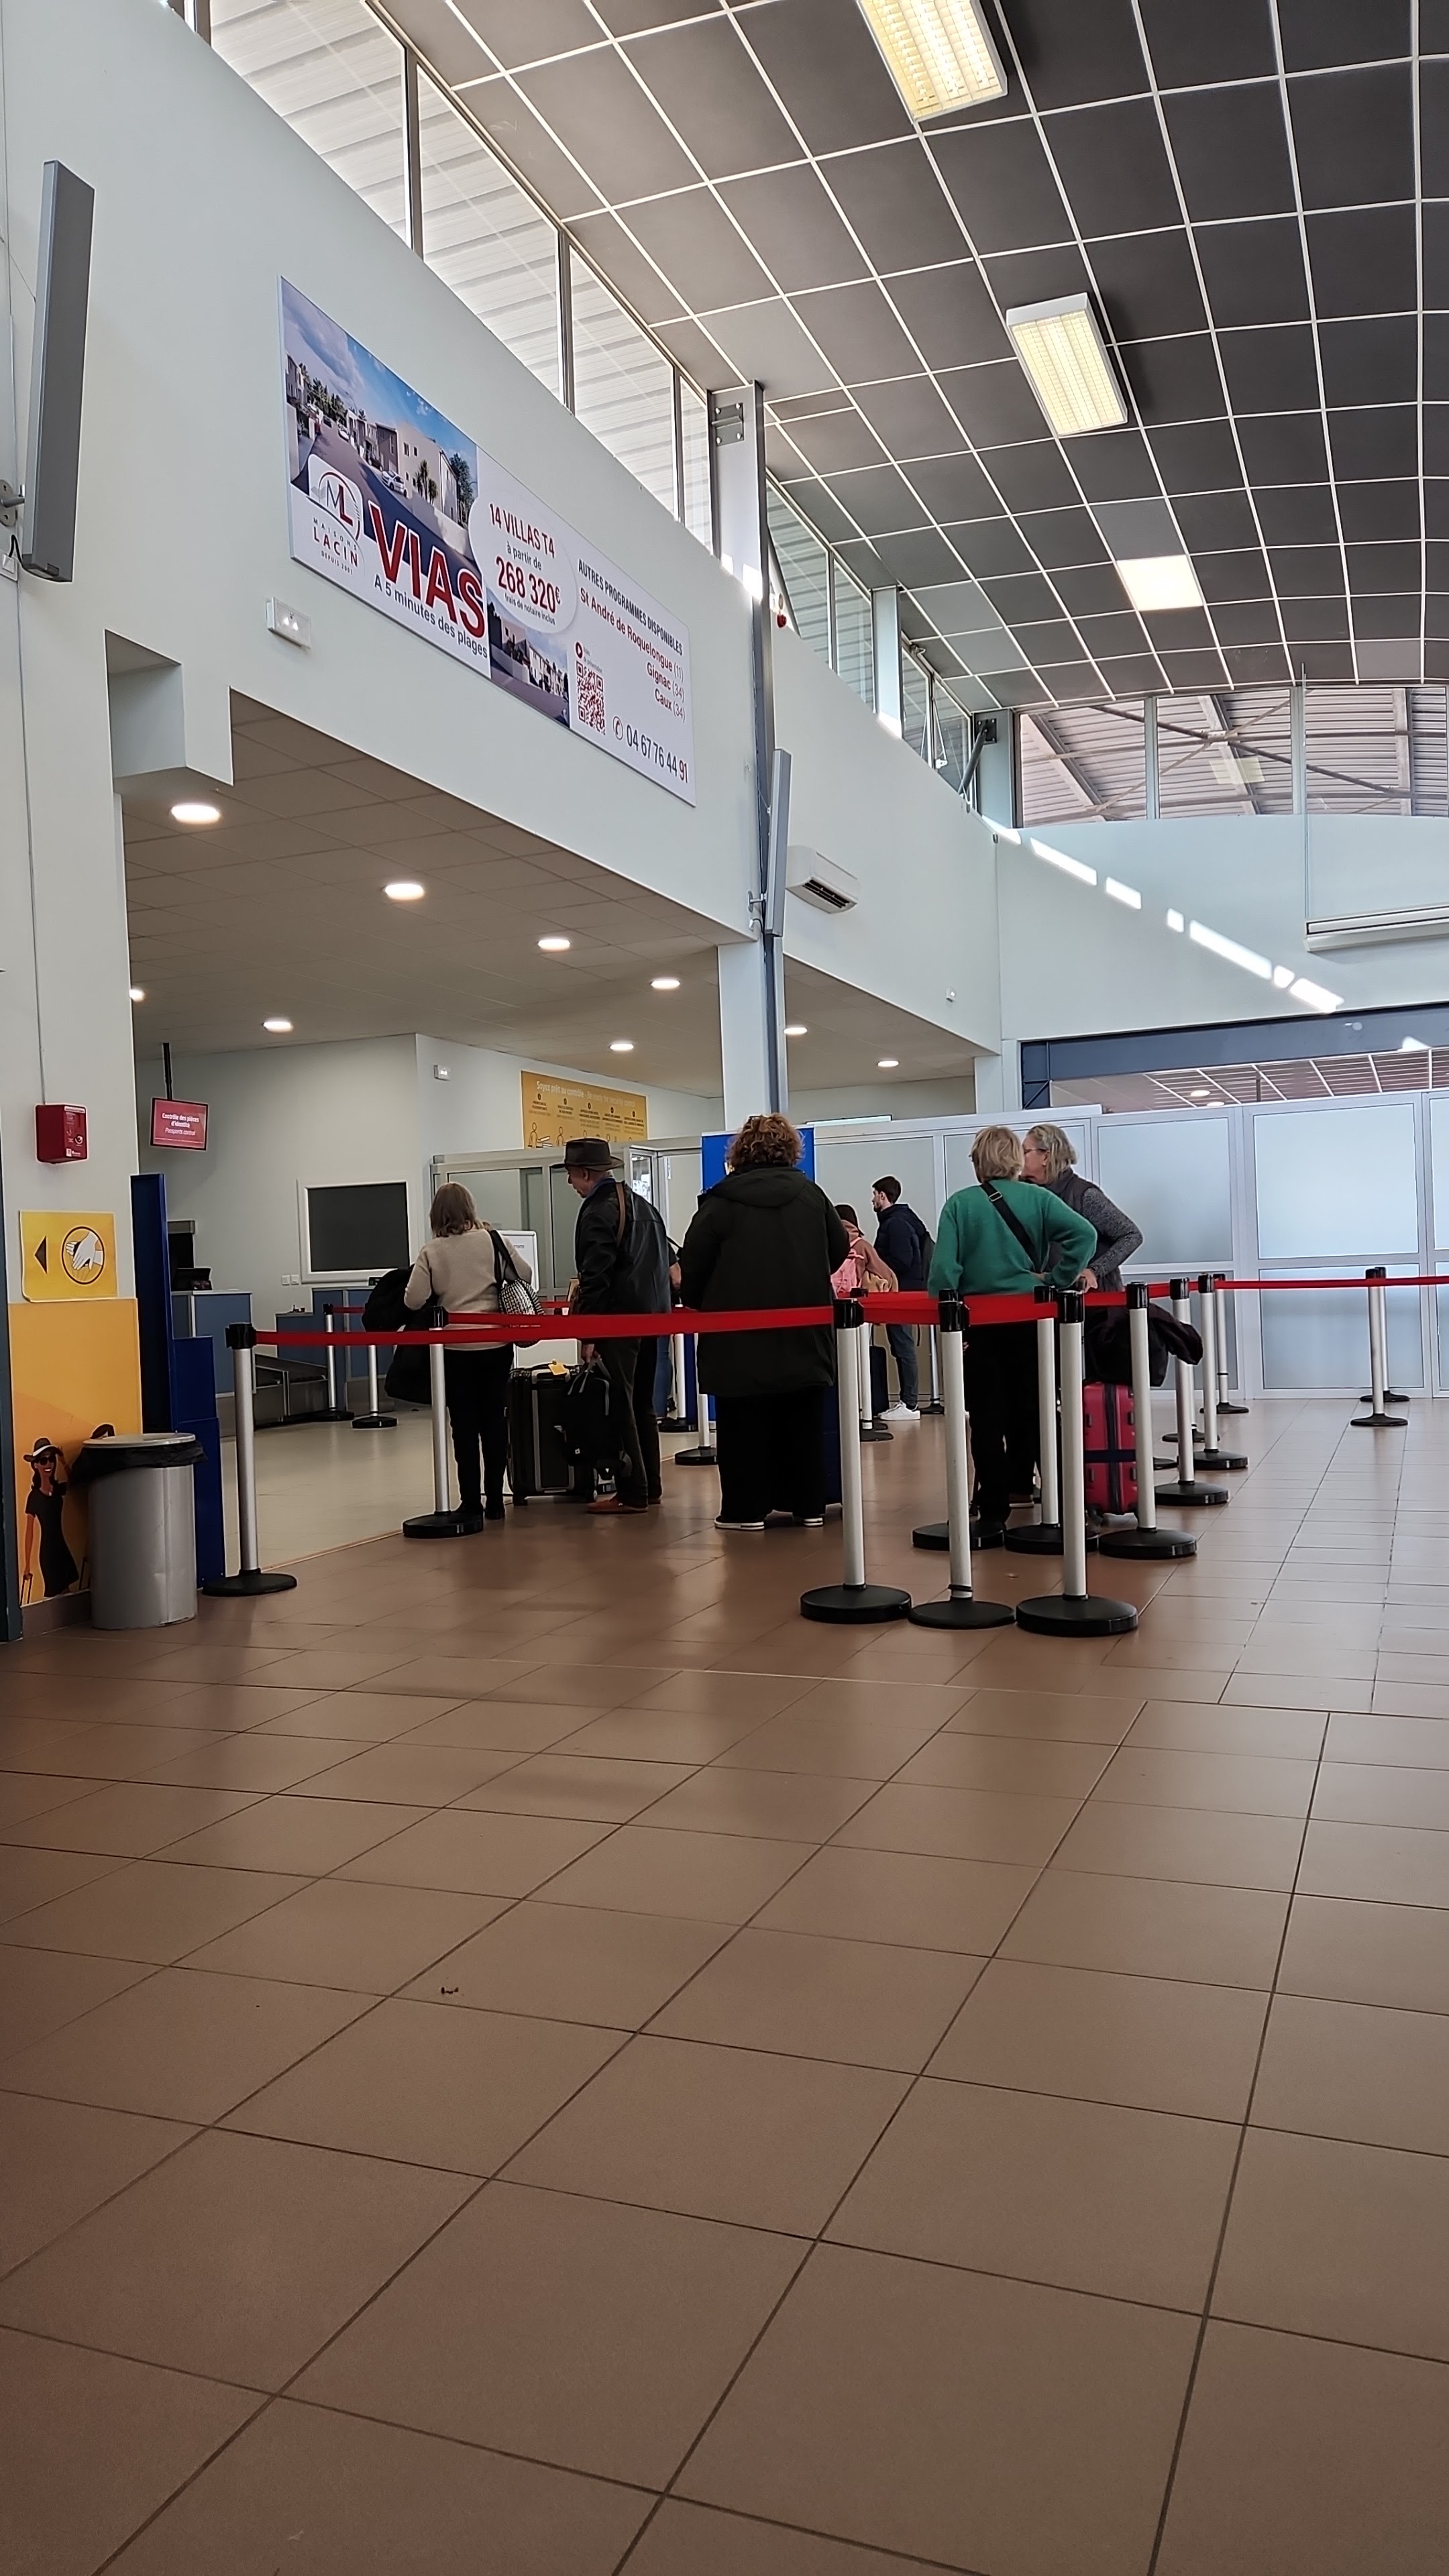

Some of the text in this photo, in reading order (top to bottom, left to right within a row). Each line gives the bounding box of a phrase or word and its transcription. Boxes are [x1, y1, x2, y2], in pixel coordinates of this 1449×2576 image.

[313, 517, 357, 551] MAISONS
[313, 526, 358, 568] LACIN
[490, 504, 555, 559] 14 VILLAS T4
[321, 550, 339, 567] DEPUIS
[369, 501, 486, 638] VIAS
[496, 555, 526, 599] 268
[507, 540, 542, 571] à partir de
[374, 574, 488, 659] A 5 minutes des plages
[504, 592, 556, 625] frais de notaire inclus
[578, 558, 683, 656] AUTRES PROGRAMMES DISPONIBLES
[580, 587, 684, 684] St André de Roquelongue (11)
[647, 661, 685, 703] Gignac (34)
[655, 688, 686, 723] Caux (34)
[626, 724, 688, 784] 04 67 76 44 91
